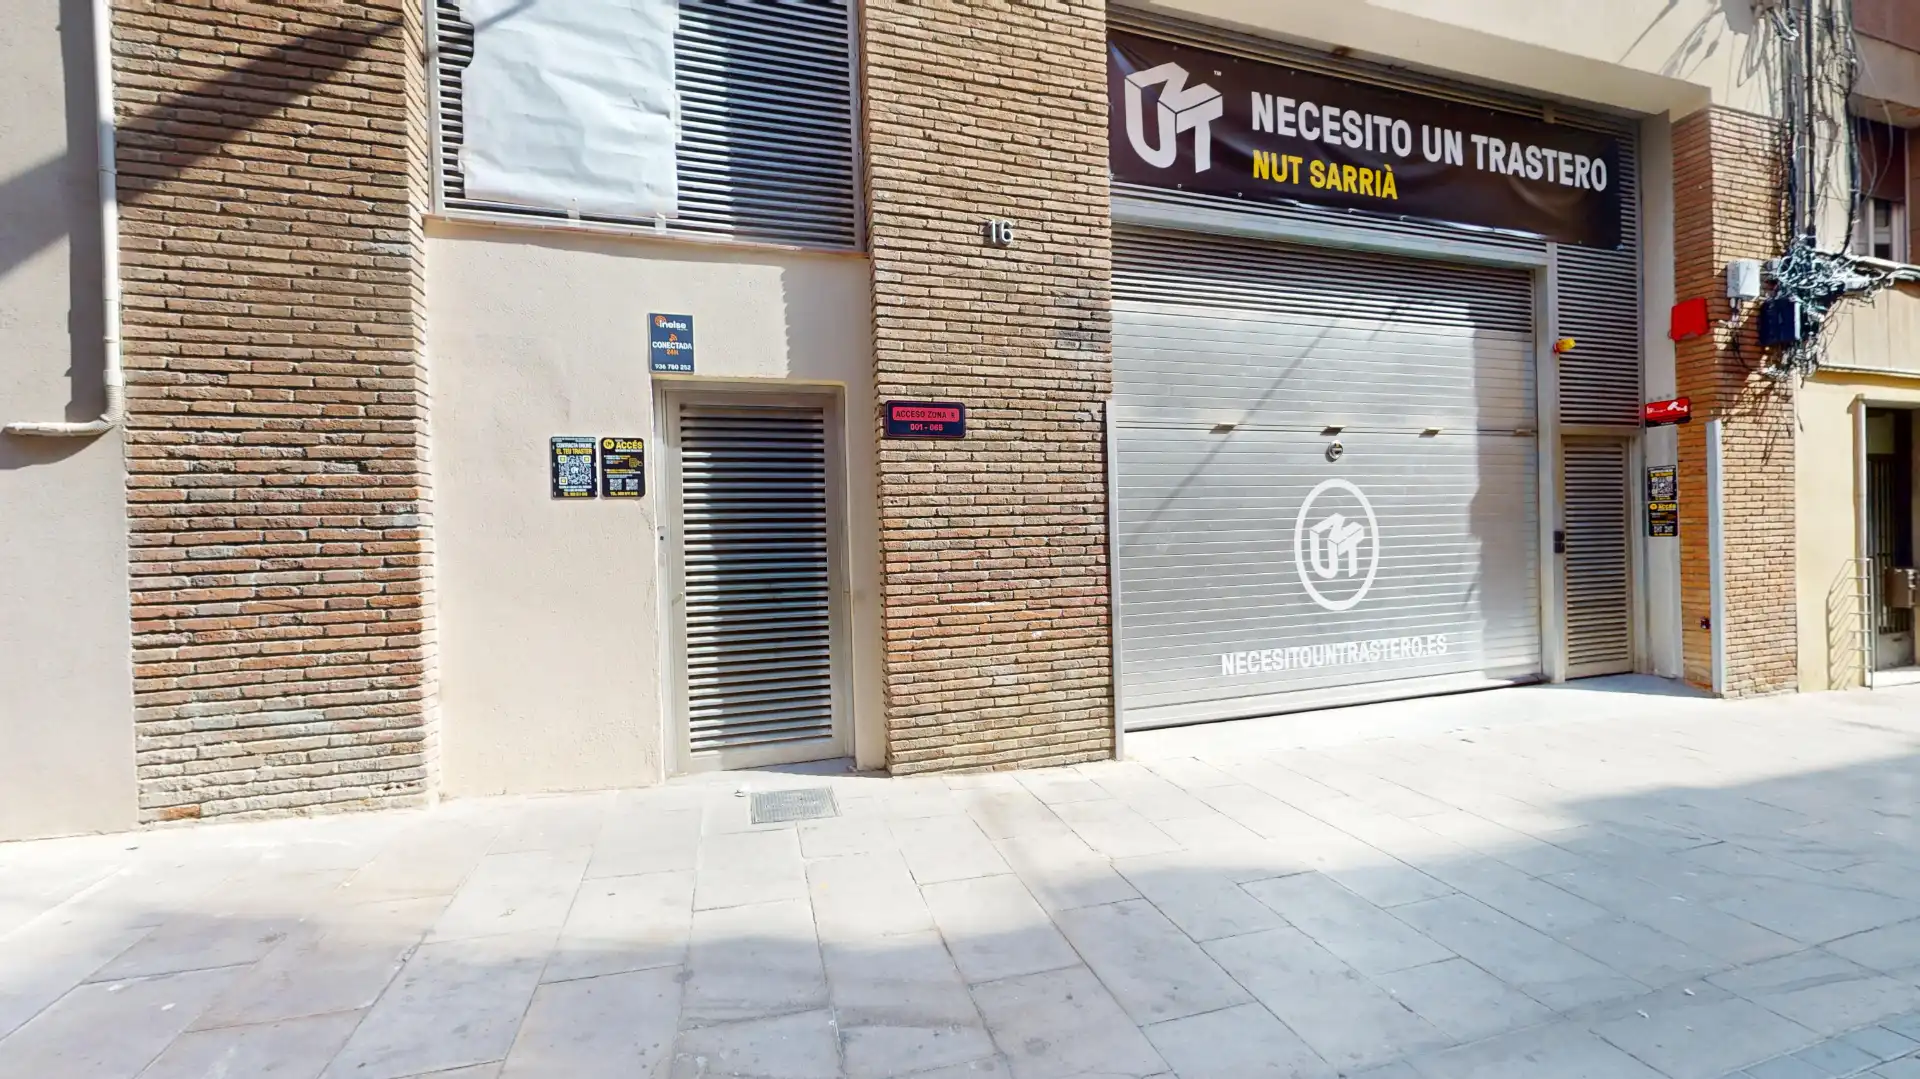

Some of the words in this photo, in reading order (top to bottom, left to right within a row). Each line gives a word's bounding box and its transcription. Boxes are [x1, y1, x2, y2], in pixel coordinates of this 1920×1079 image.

[1251, 91, 1412, 157] NECESITO
[1422, 124, 1463, 166] UN
[1470, 133, 1607, 192] TRASTERO
[1252, 149, 1303, 185] NUT
[1309, 163, 1398, 200] SARRIÀ
[991, 219, 1014, 243] 16
[652, 341, 692, 350] CONECTADA
[896, 410, 925, 418] ACCESO
[616, 440, 643, 449] ACCÉS
[1221, 634, 1448, 675] NECESITOUNTRASTERO.ES
